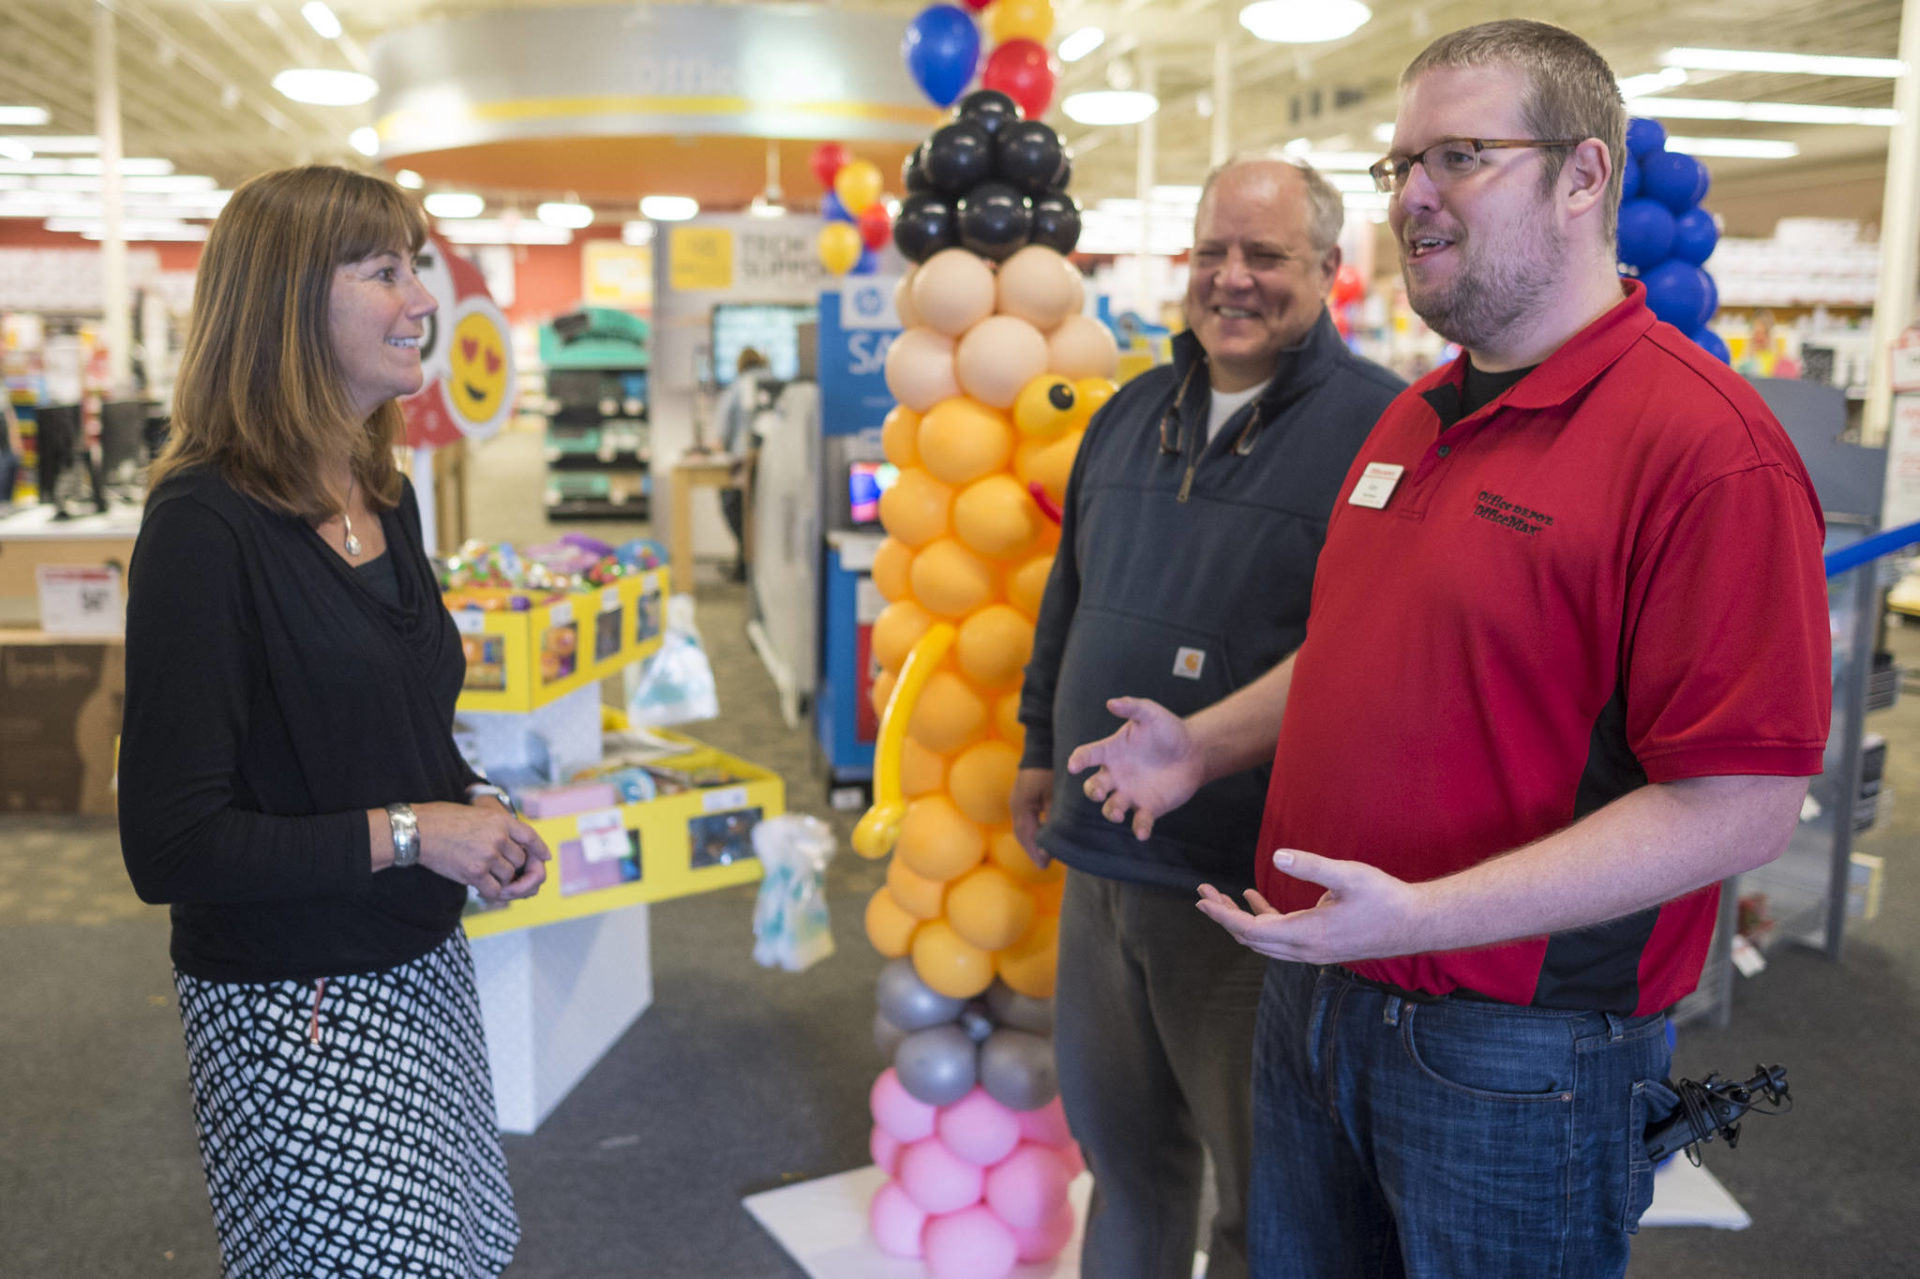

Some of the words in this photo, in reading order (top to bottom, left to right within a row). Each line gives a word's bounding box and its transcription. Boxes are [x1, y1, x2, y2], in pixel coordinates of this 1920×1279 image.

[742, 258, 828, 282] SUPPO
[848, 333, 893, 375] SA
[1478, 490, 1513, 511] Office
[1512, 505, 1554, 526] DEPOT
